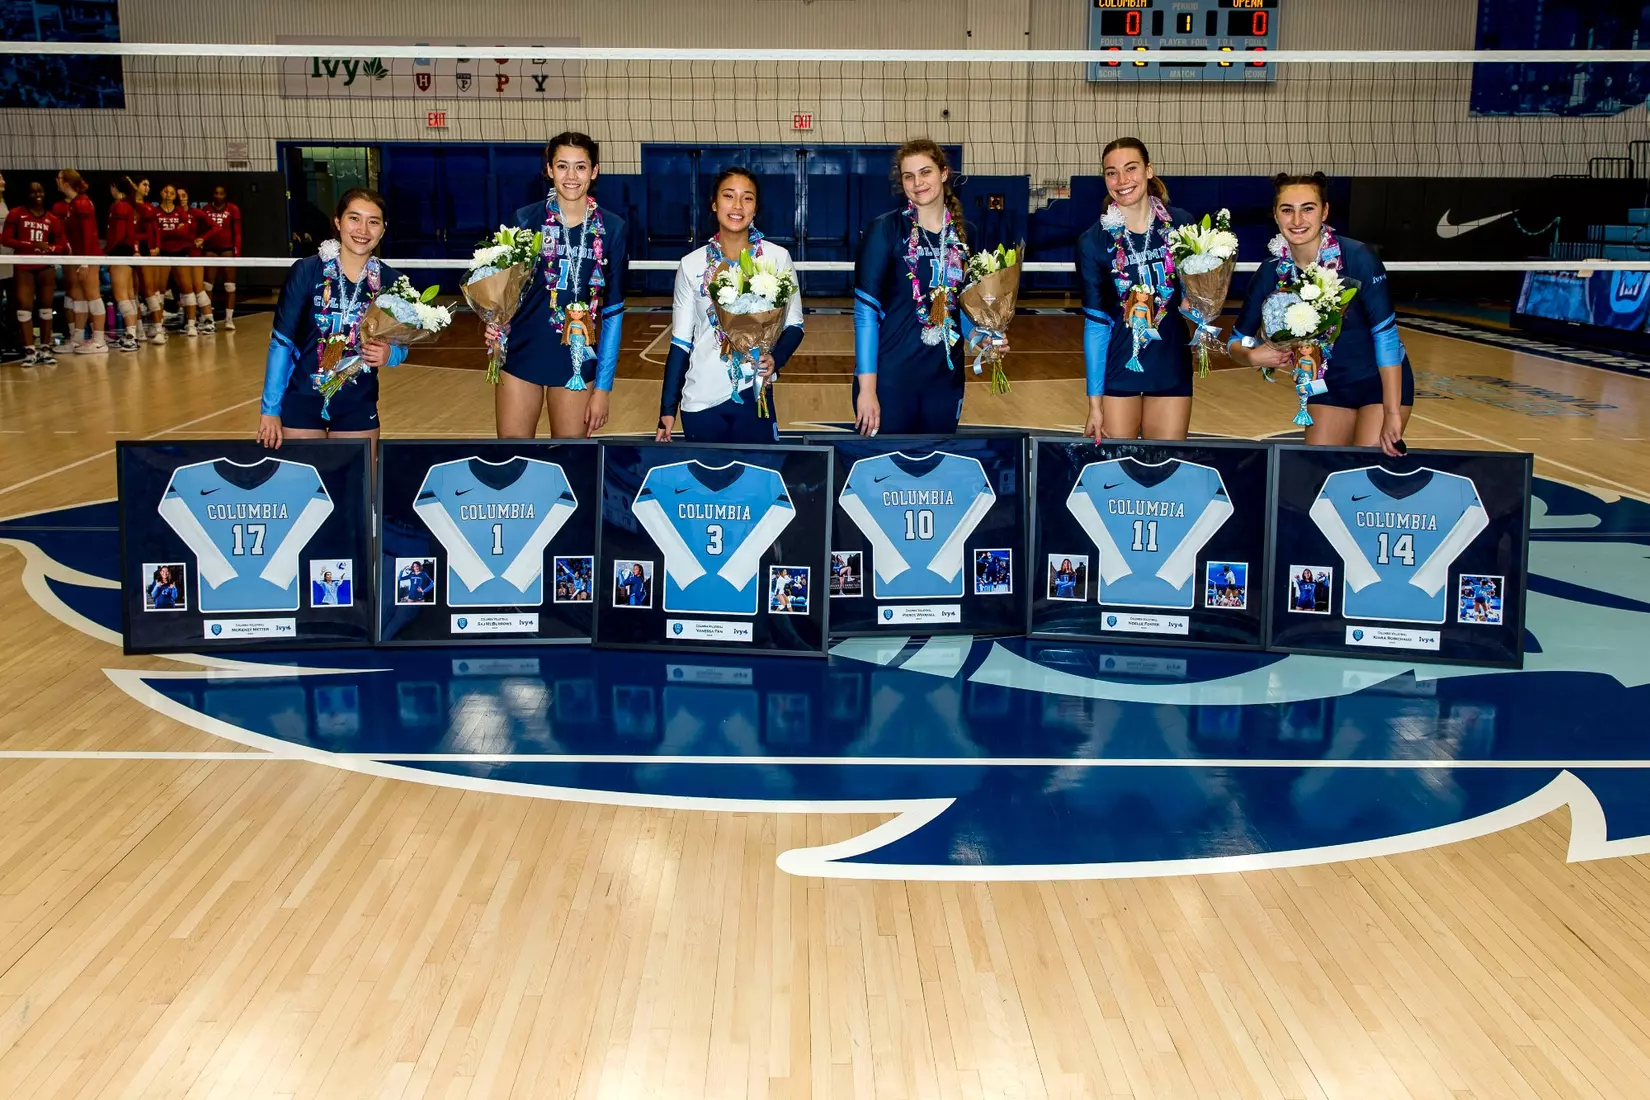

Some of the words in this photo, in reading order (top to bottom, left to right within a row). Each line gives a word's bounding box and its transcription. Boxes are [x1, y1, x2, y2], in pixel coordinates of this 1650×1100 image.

[1099, 0, 1147, 8] COLUMBIA
[1126, 10, 1141, 35] 0
[1185, 14, 1191, 32] 1
[1253, 10, 1267, 35] 0
[1101, 38, 1124, 46] FOULS
[1160, 38, 1187, 46] PLAYER
[1191, 38, 1209, 46] FOUL
[1245, 38, 1268, 46] FOULS
[311, 57, 360, 86] Ivy
[1098, 69, 1121, 78] SCORE
[1169, 70, 1196, 78] MATCH
[495, 74, 509, 92] P
[532, 74, 548, 92] Y
[428, 112, 446, 126] EXIT
[793, 114, 812, 128] EXIT
[24, 220, 49, 231] PENN
[30, 229, 43, 242] 10
[556, 259, 570, 289] 1
[882, 490, 954, 507] COLUMBIA
[206, 503, 289, 520] COLUMBIA
[459, 503, 535, 521] COLUMBIA
[678, 503, 751, 521] COLUMBIA
[1108, 498, 1185, 518] COLUMBIA
[904, 509, 935, 541] 10
[1356, 511, 1437, 531] COLUMBIA
[231, 524, 267, 556] 17
[491, 523, 504, 555] 1
[705, 523, 724, 556] 3
[1131, 520, 1158, 552] 11
[1377, 532, 1416, 566] 14
